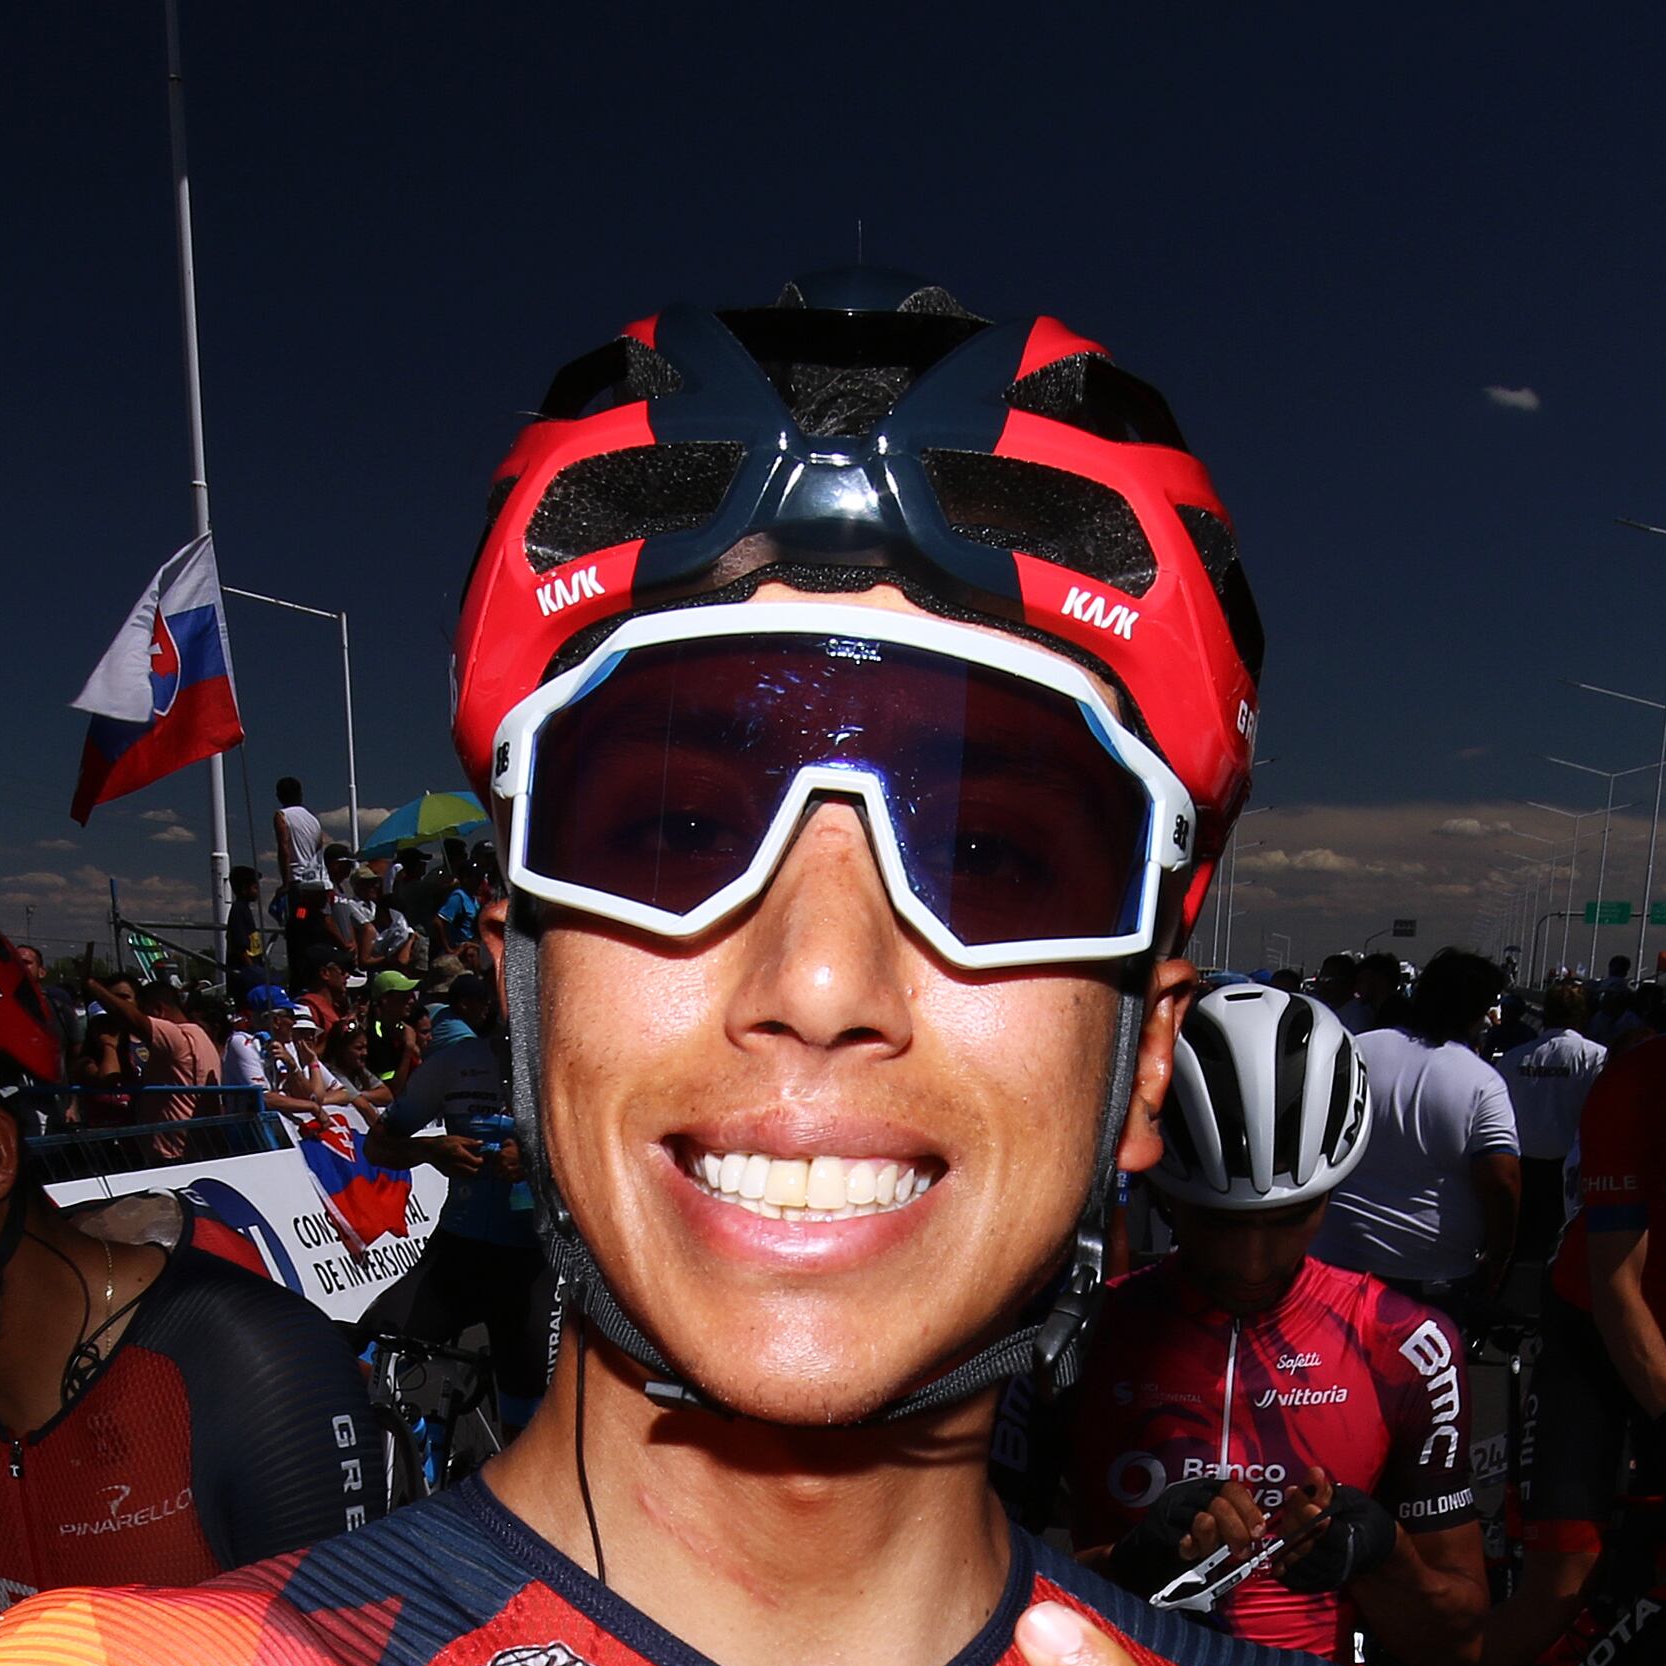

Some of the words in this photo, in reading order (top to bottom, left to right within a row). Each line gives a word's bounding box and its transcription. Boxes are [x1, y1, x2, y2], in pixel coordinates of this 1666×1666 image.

[313, 1258, 345, 1295] DE
[1276, 1351, 1323, 1376] Safetti
[1278, 1384, 1349, 1408] vittoria
[1182, 1457, 1287, 1484] Banco
[59, 1487, 194, 1537] PINARELLO
